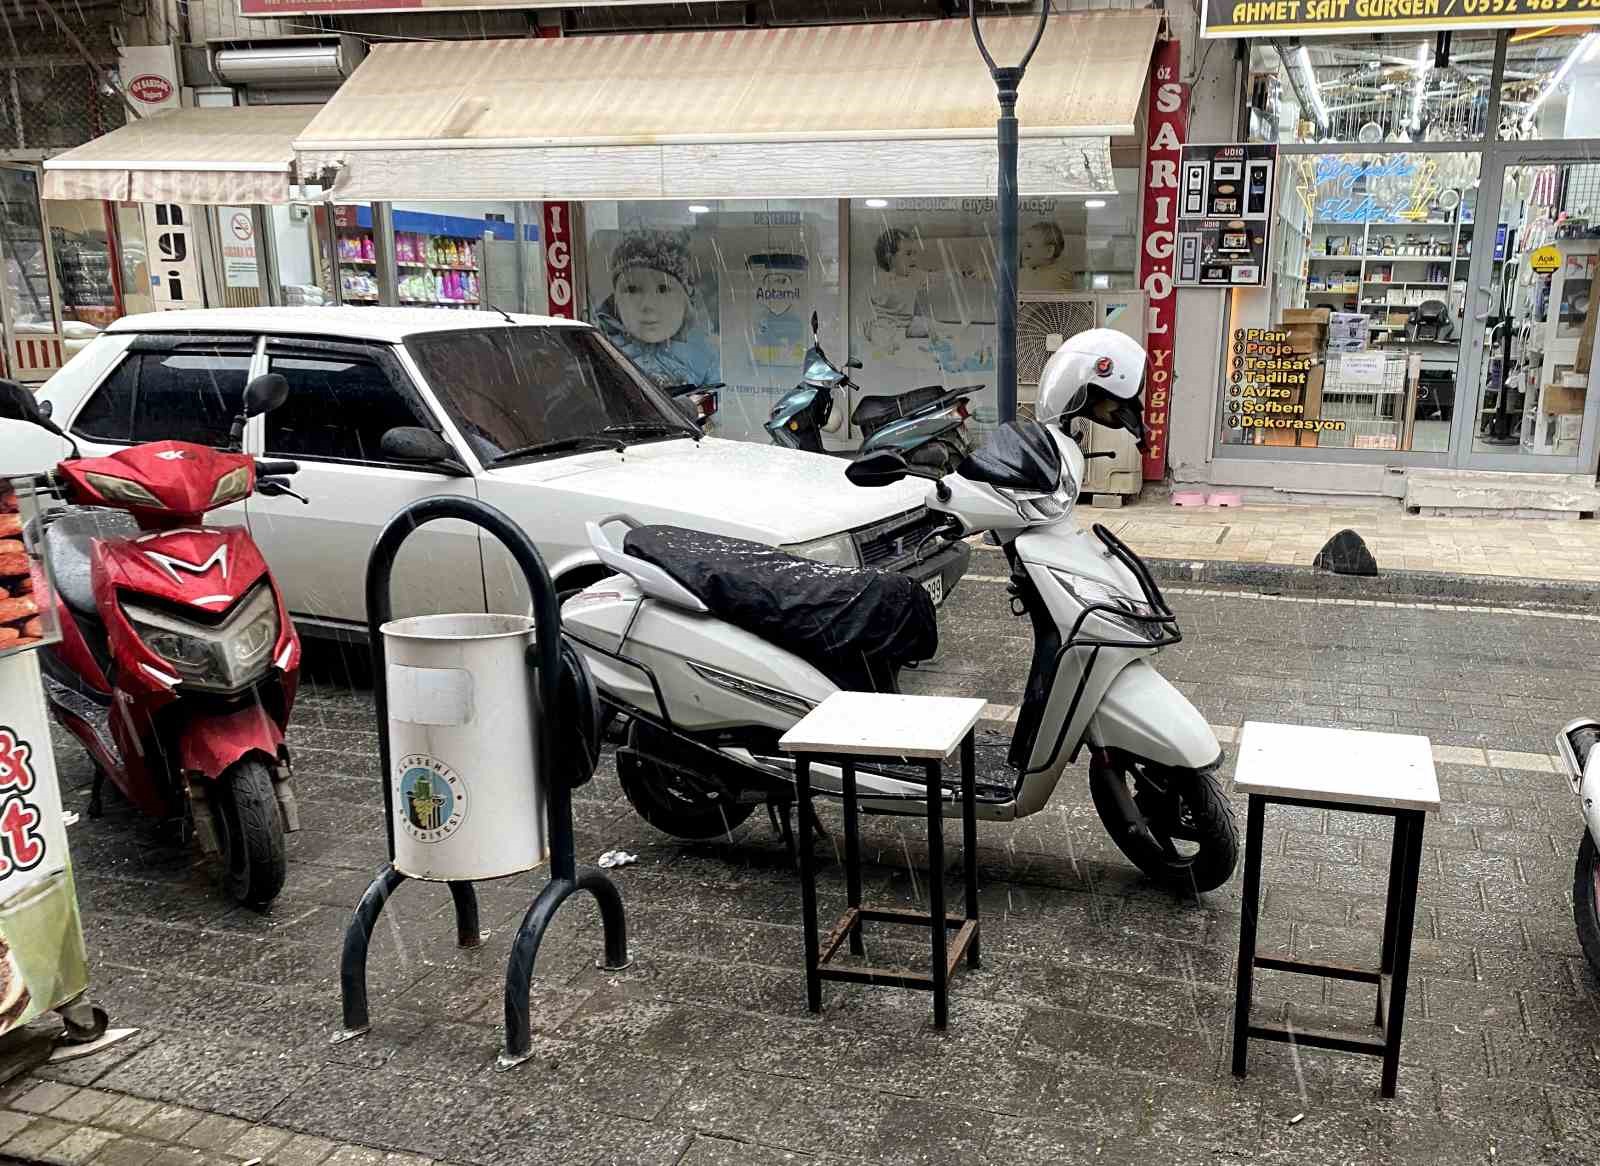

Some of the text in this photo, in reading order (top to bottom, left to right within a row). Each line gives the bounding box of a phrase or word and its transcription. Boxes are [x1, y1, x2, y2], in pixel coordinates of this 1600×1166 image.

[1232, 1, 1300, 24] AHMET
[1157, 65, 1171, 80] ÖZ
[1144, 83, 1182, 334] SARIGÖL
[548, 206, 572, 317] IGÖ
[756, 287, 800, 301] Aptamil
[1247, 329, 1287, 342] Plan
[1246, 342, 1293, 356] Proje
[1245, 357, 1311, 370] Tesisat
[1244, 370, 1306, 383] Tadilat
[1242, 384, 1291, 398] Avize
[1242, 400, 1304, 414] Şofben
[1241, 415, 1346, 432] Dekorasyon
